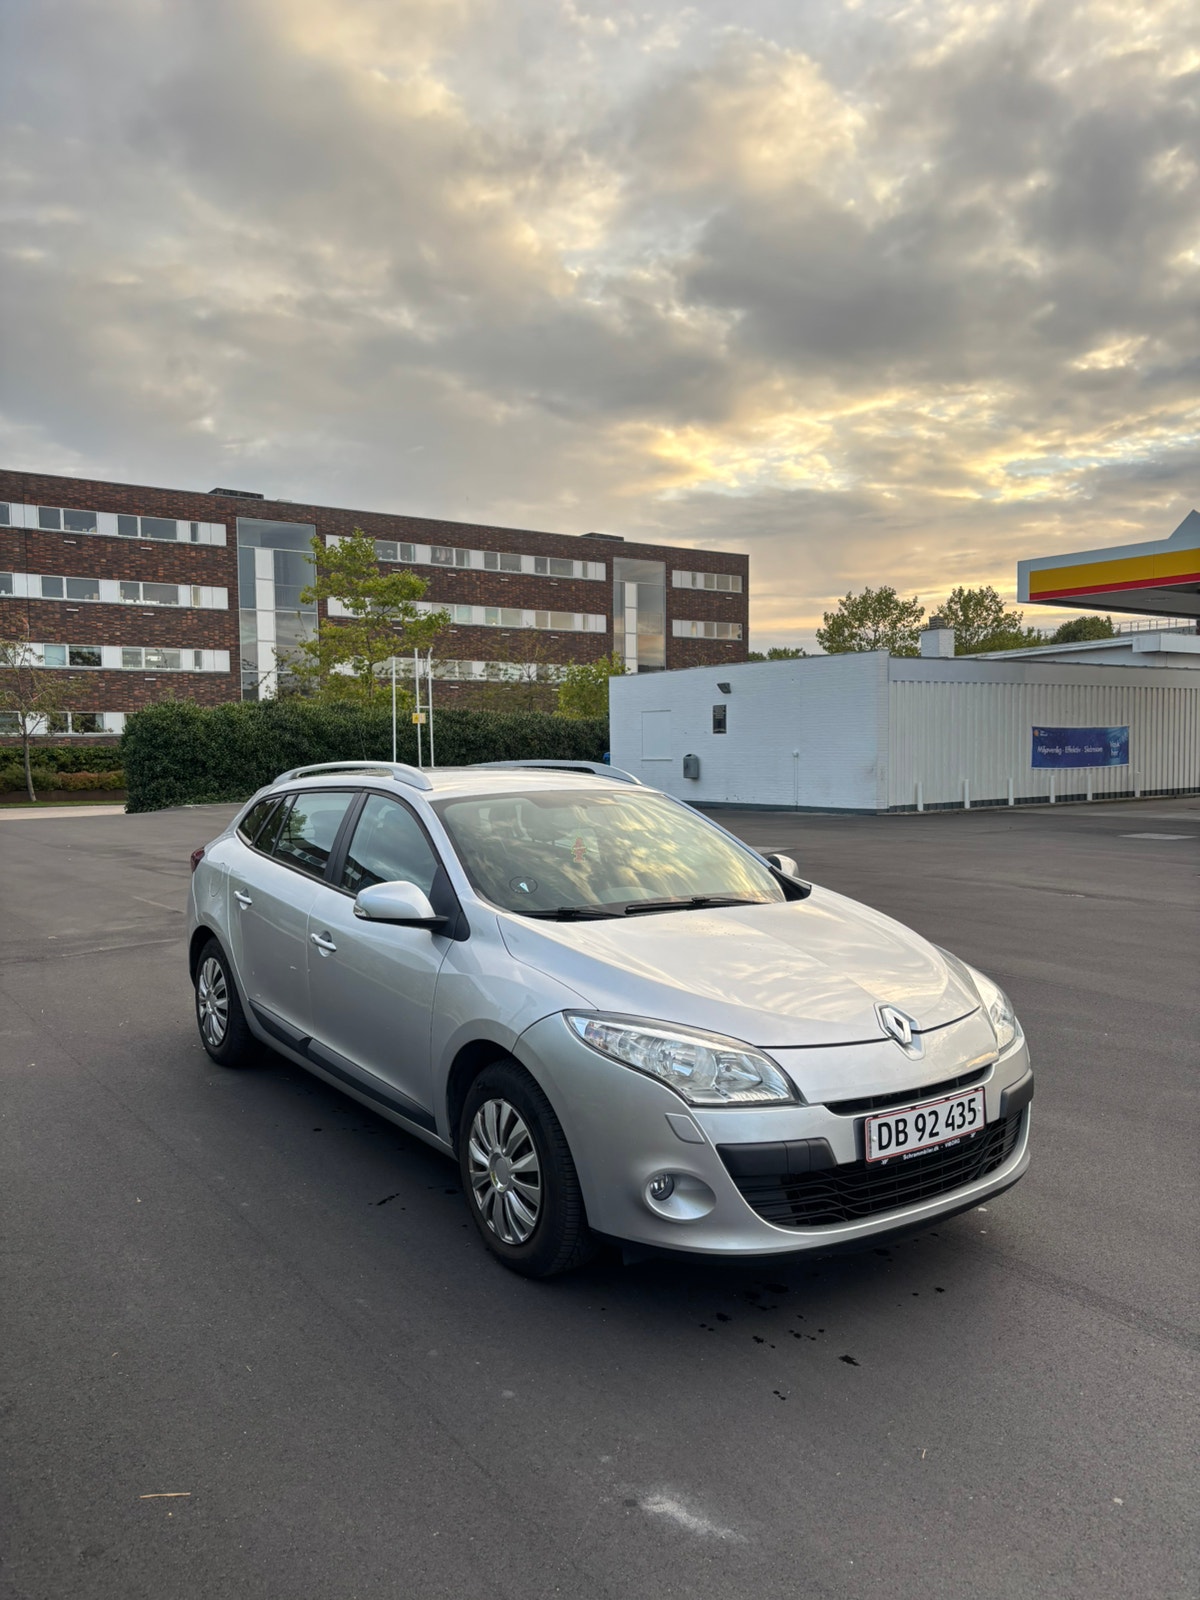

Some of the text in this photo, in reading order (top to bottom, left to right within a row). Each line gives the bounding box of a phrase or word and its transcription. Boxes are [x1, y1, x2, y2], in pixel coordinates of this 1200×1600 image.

[878, 1098, 977, 1151] DB 92 435
